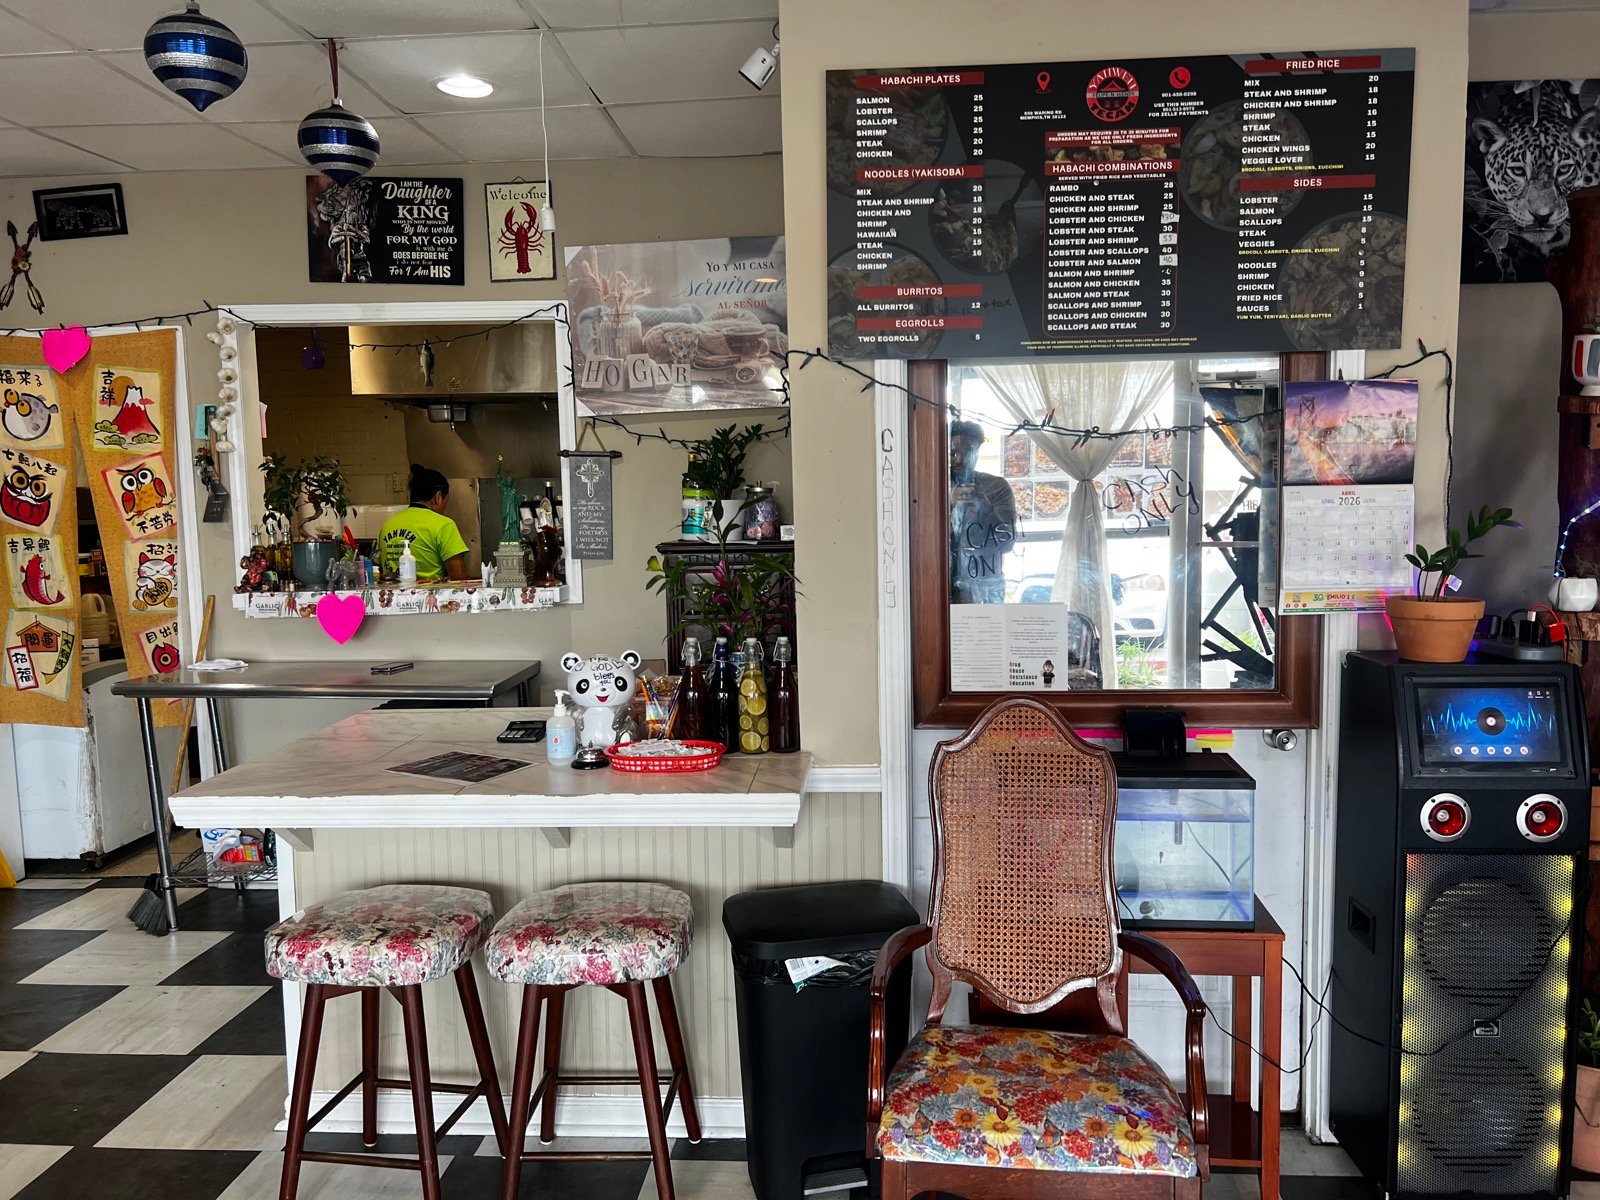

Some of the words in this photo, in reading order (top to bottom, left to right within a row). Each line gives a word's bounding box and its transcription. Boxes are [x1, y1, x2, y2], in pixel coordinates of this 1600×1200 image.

[926, 75, 960, 83] PLATES
[1098, 162, 1172, 171] COMBINATIONS
[865, 170, 909, 178] NOODLES
[912, 168, 964, 177] (YAKISOBA)
[382, 182, 452, 203] Daughter
[490, 186, 546, 200] Welcome
[397, 206, 449, 222] KING
[402, 224, 415, 235] By
[857, 229, 896, 238] HAWAIIAN
[386, 236, 410, 245] FOR
[412, 236, 430, 245] MY
[432, 236, 457, 245] GOD
[389, 266, 403, 276] For
[413, 267, 429, 276] Am
[430, 266, 451, 278] HIS
[734, 298, 767, 308] SEÑOR
[586, 358, 688, 386] HOGAR
[1102, 465, 1184, 510] CASH
[1338, 497, 1360, 506] 2026
[384, 528, 416, 544] YAHWEH
